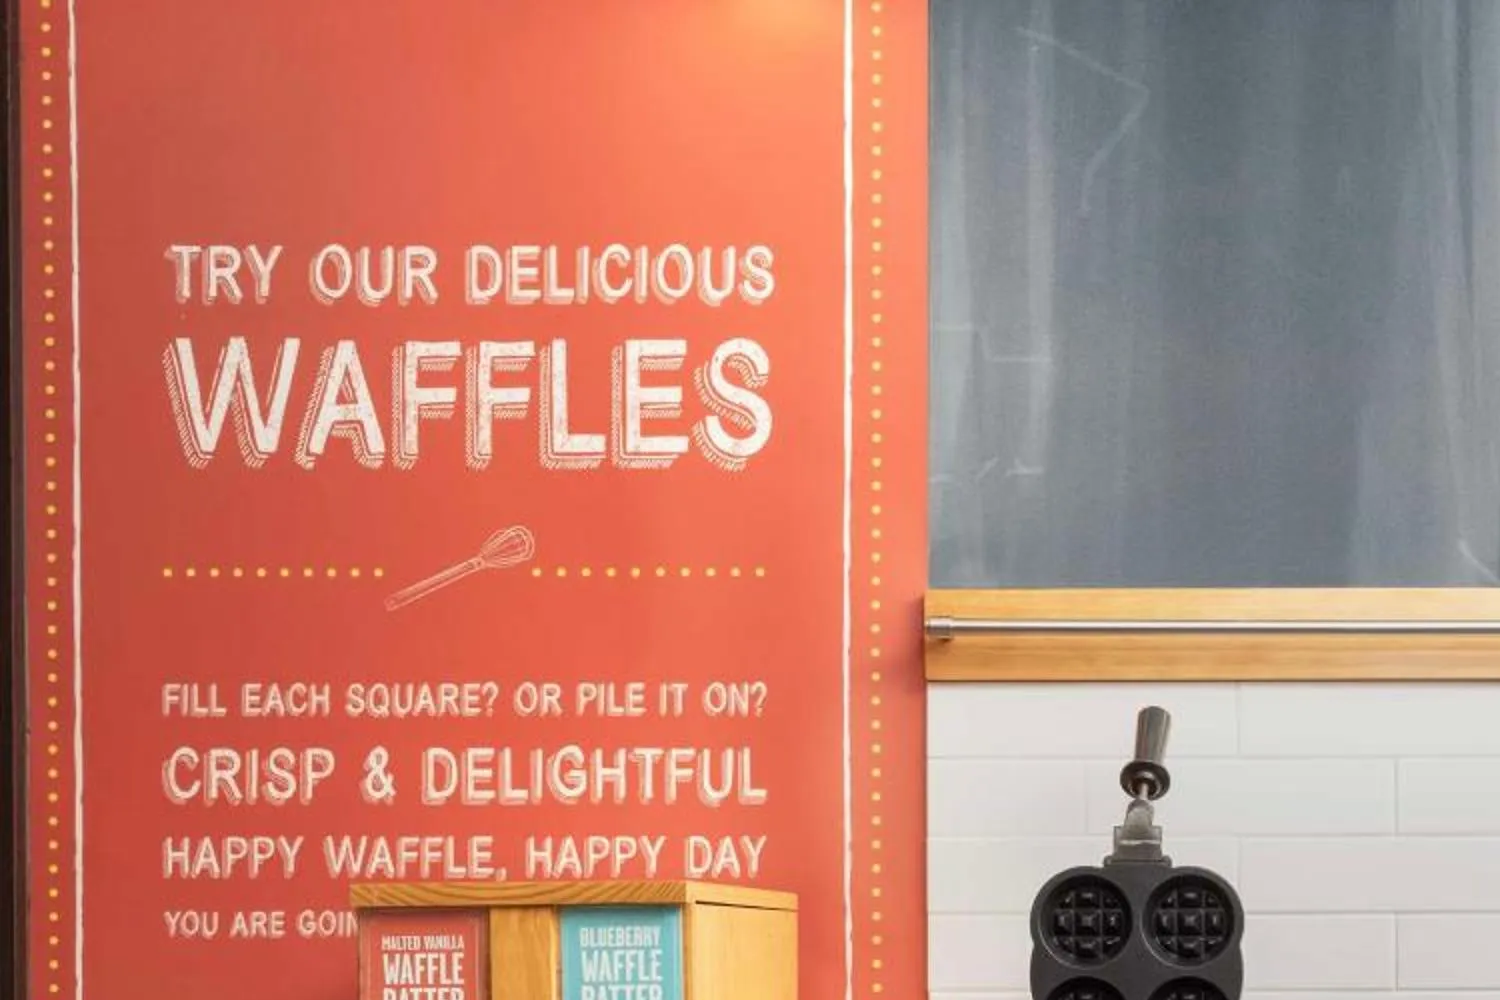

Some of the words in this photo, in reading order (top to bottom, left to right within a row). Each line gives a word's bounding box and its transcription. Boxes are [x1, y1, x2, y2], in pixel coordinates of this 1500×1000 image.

[166, 245, 282, 305] TRY
[310, 243, 438, 305] OUR
[465, 244, 775, 306] DELICIOUS
[163, 336, 772, 472] WAFFLES
[162, 683, 226, 716] FILL
[242, 683, 330, 716] EACH
[345, 682, 499, 716] SQUARE?
[513, 682, 562, 716] OR
[576, 682, 647, 716] PILE
[659, 682, 688, 715] IT
[703, 681, 768, 715] ON?
[162, 747, 335, 805] CRISP
[360, 746, 395, 804] &
[421, 745, 768, 806] DELIGHTFUL
[162, 836, 303, 878] HAPPY
[324, 836, 507, 882] WAFFLE,
[526, 836, 667, 878] HAPPY
[684, 836, 768, 878] DAY
[163, 911, 220, 937] YOU
[230, 911, 285, 937] ARE
[296, 910, 358, 938] GOIN
[579, 926, 661, 948] BLUEBERRY
[382, 935, 421, 951] MALTED
[424, 935, 464, 950] VANILLA
[383, 952, 464, 985] WAFFLE
[581, 949, 663, 983] WAFFLE
